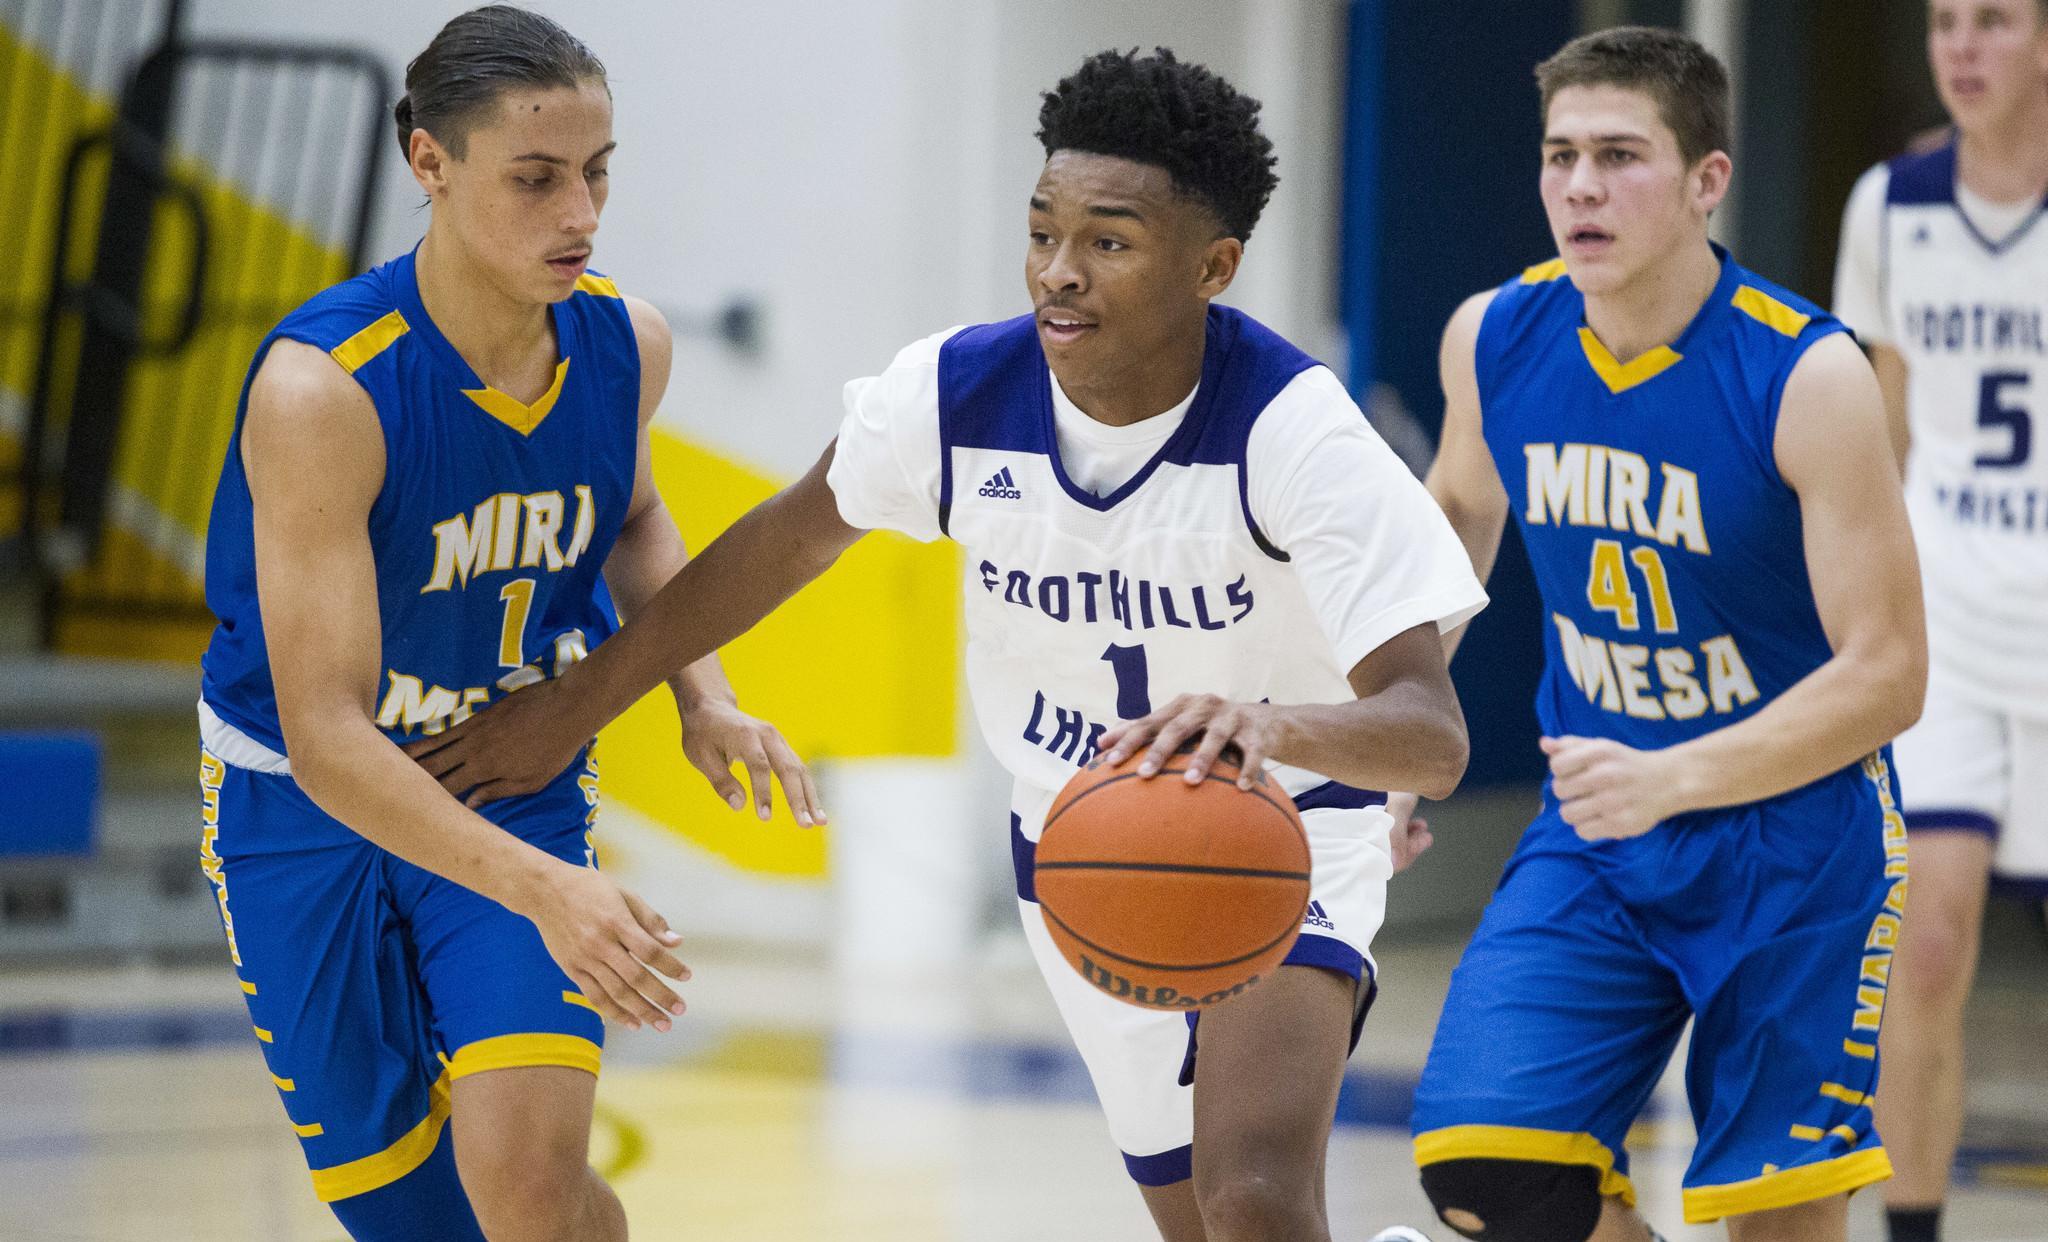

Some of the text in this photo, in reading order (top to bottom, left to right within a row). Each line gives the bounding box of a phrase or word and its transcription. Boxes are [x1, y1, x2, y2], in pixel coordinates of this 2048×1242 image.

[1974, 370, 2031, 467] 5
[979, 486, 1021, 499] adidas
[1523, 442, 1711, 555] MIRA
[499, 578, 536, 668] 1
[979, 559, 1254, 631] FOOTHILLS
[1587, 538, 1679, 634] 41
[1100, 642, 1151, 720] 1
[1552, 611, 1760, 721] MESA
